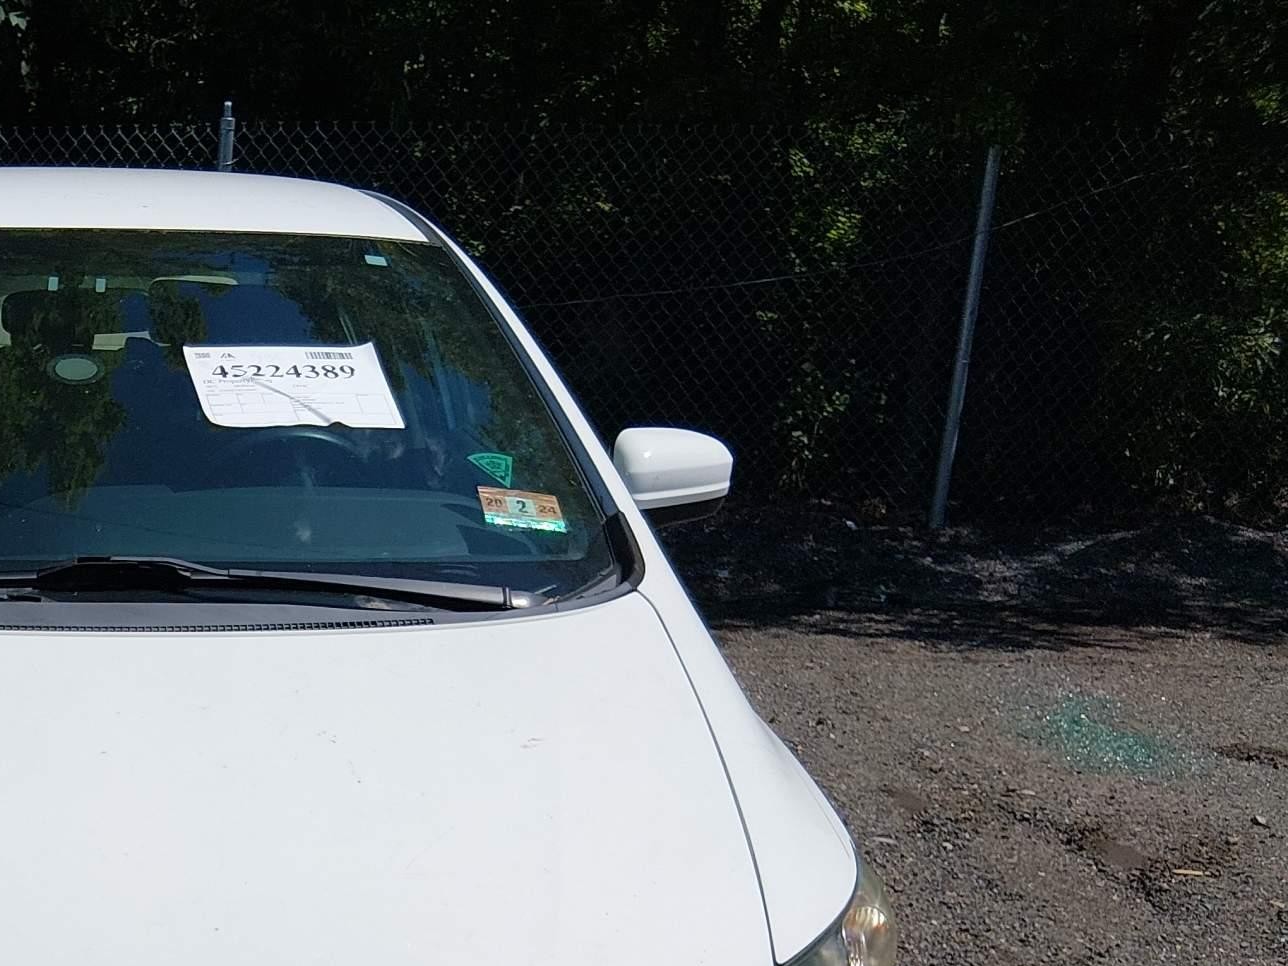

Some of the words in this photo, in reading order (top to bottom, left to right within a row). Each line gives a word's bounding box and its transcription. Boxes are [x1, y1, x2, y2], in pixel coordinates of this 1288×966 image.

[211, 364, 356, 379] 45224389
[485, 497, 503, 508] 20
[516, 500, 529, 513] 2
[539, 505, 557, 514] 24
